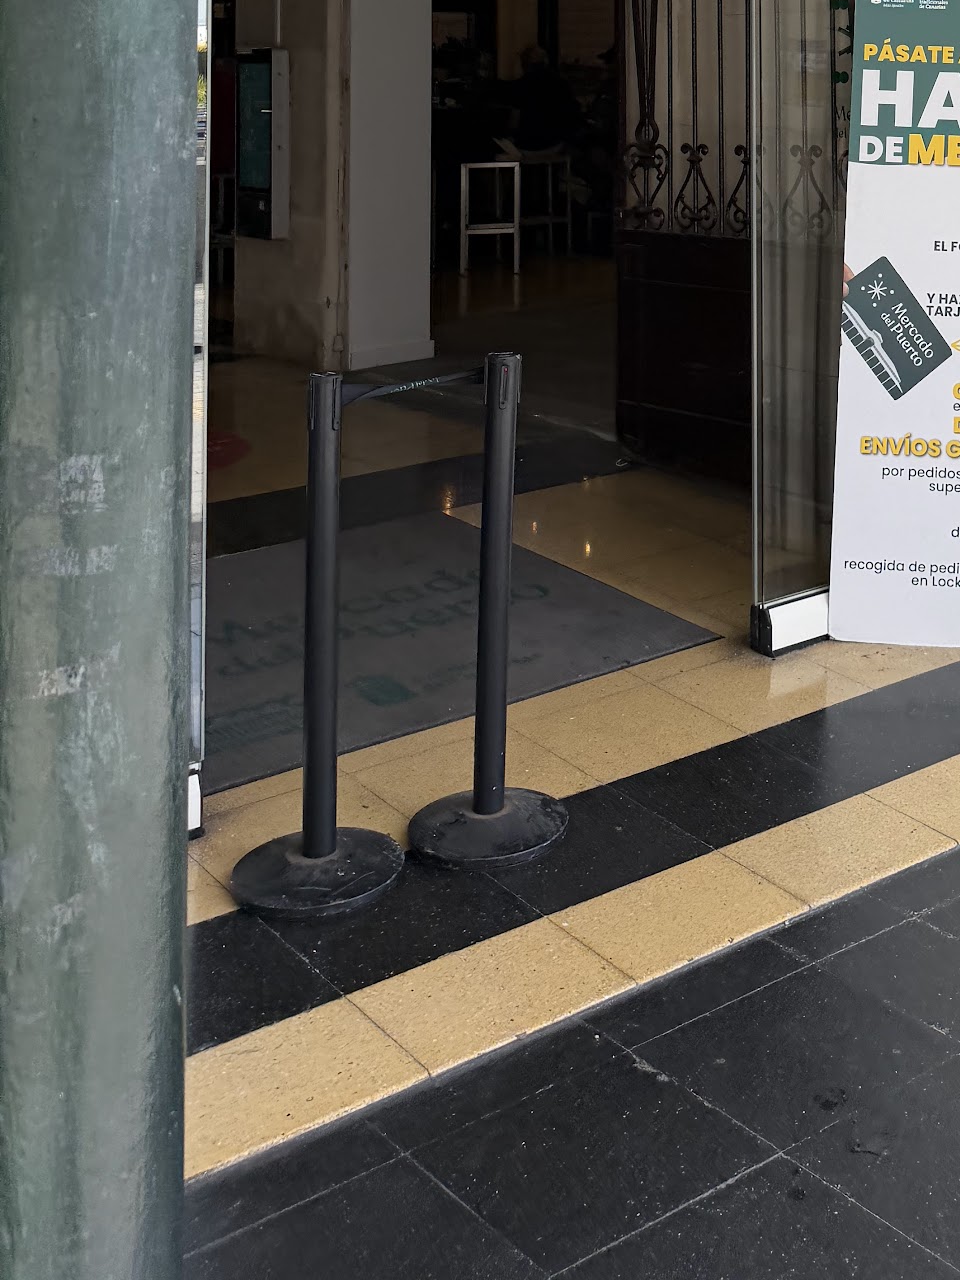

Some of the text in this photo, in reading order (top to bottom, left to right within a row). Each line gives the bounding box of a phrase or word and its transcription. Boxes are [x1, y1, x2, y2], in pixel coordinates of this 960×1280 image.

[863, 38, 955, 64] PÁSATE
[858, 135, 904, 163] DE
[933, 240, 948, 252] EL
[926, 293, 936, 304] Y
[880, 312, 923, 368] del Puerto
[891, 302, 934, 359] Mercado
[859, 433, 941, 458] ENVÍOS
[881, 466, 905, 479] por
[844, 559, 905, 574] recogida
[908, 560, 926, 573] de
[911, 576, 928, 587] en
